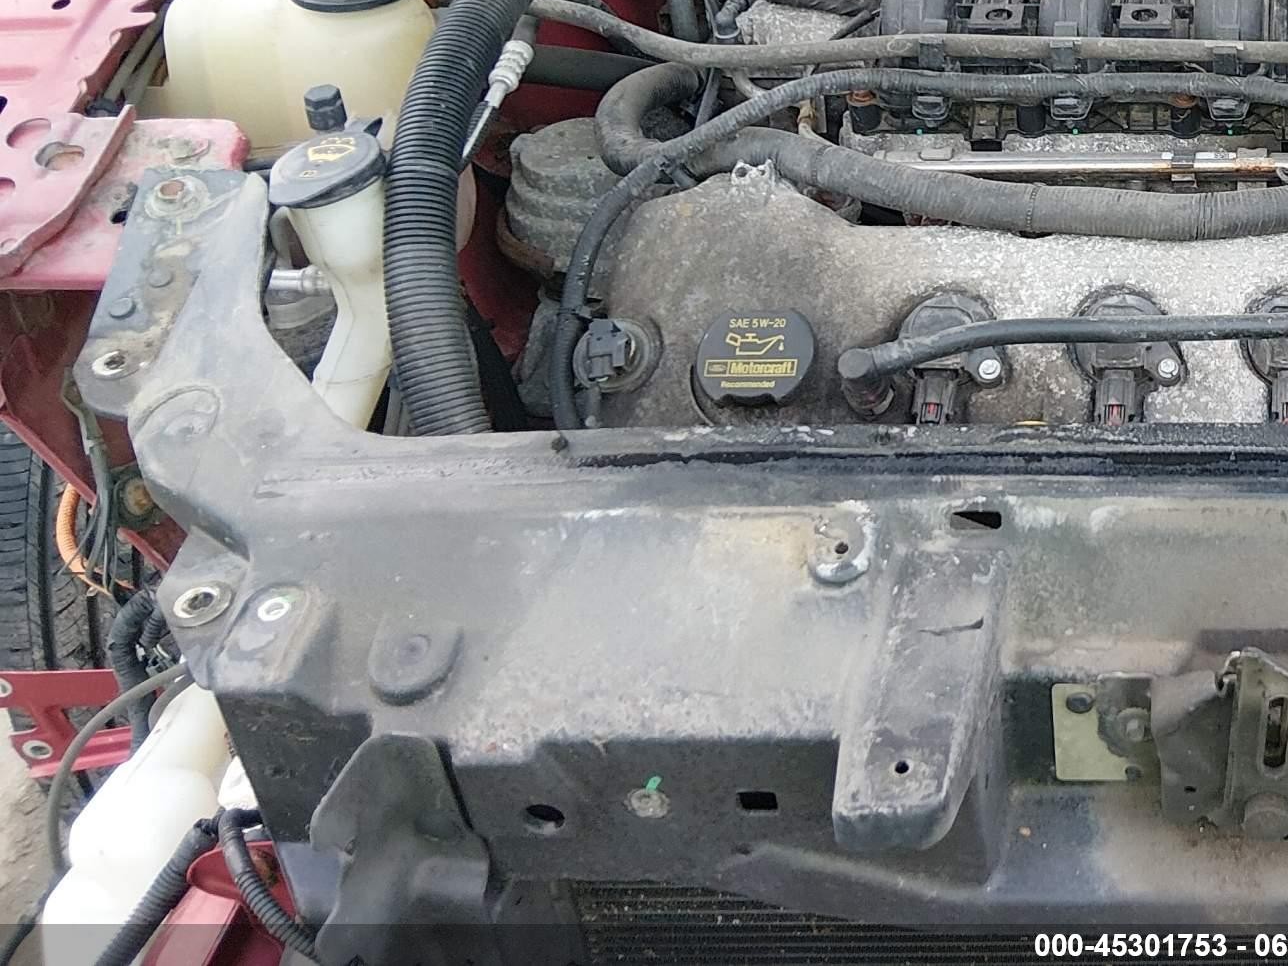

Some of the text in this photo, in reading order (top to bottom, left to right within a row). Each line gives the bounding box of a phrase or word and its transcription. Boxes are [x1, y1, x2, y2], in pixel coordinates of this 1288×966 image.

[729, 318, 787, 328] SAE 5W-20
[730, 361, 792, 374] Motorcraft
